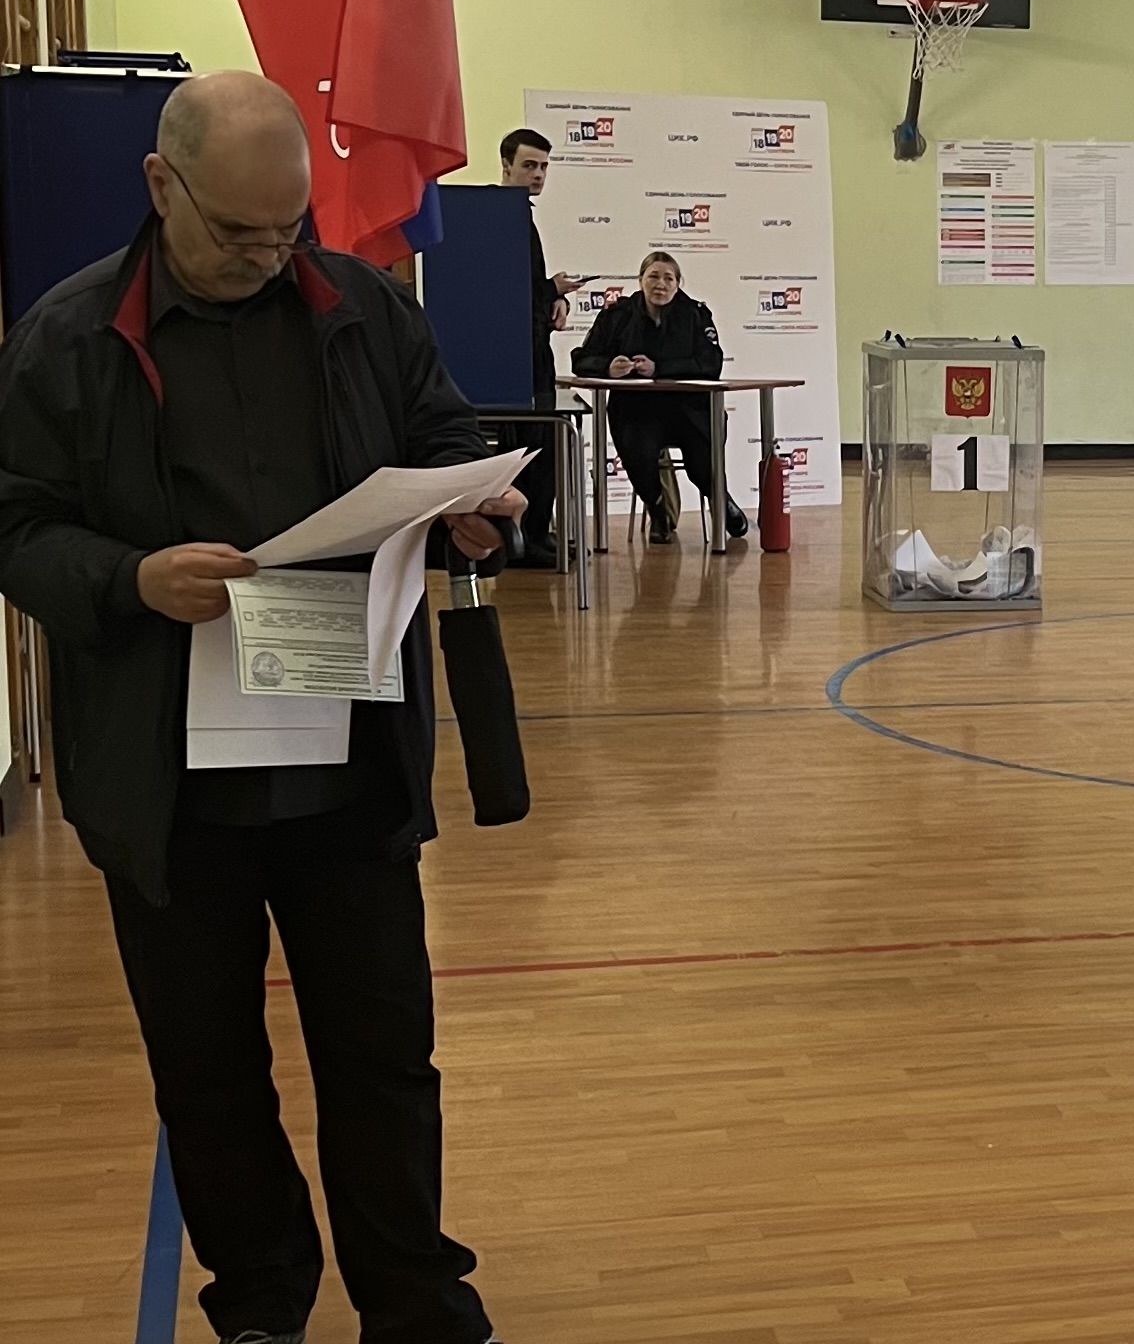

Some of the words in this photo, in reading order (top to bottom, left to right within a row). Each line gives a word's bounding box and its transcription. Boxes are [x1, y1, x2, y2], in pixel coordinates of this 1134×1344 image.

[569, 131, 581, 142] 18
[582, 126, 595, 137] 19
[596, 121, 612, 133] 20
[753, 138, 765, 149] 18
[766, 133, 778, 144] 19
[779, 128, 793, 140] 20
[667, 219, 679, 229] 18
[680, 212, 692, 224] 19
[694, 208, 708, 220] 20
[579, 301, 591, 312] 18
[592, 295, 605, 307] 19
[761, 301, 772, 312] 18
[773, 295, 785, 306] 19
[786, 290, 800, 302] 20
[792, 451, 806, 463] 20
[956, 436, 979, 491] 1
